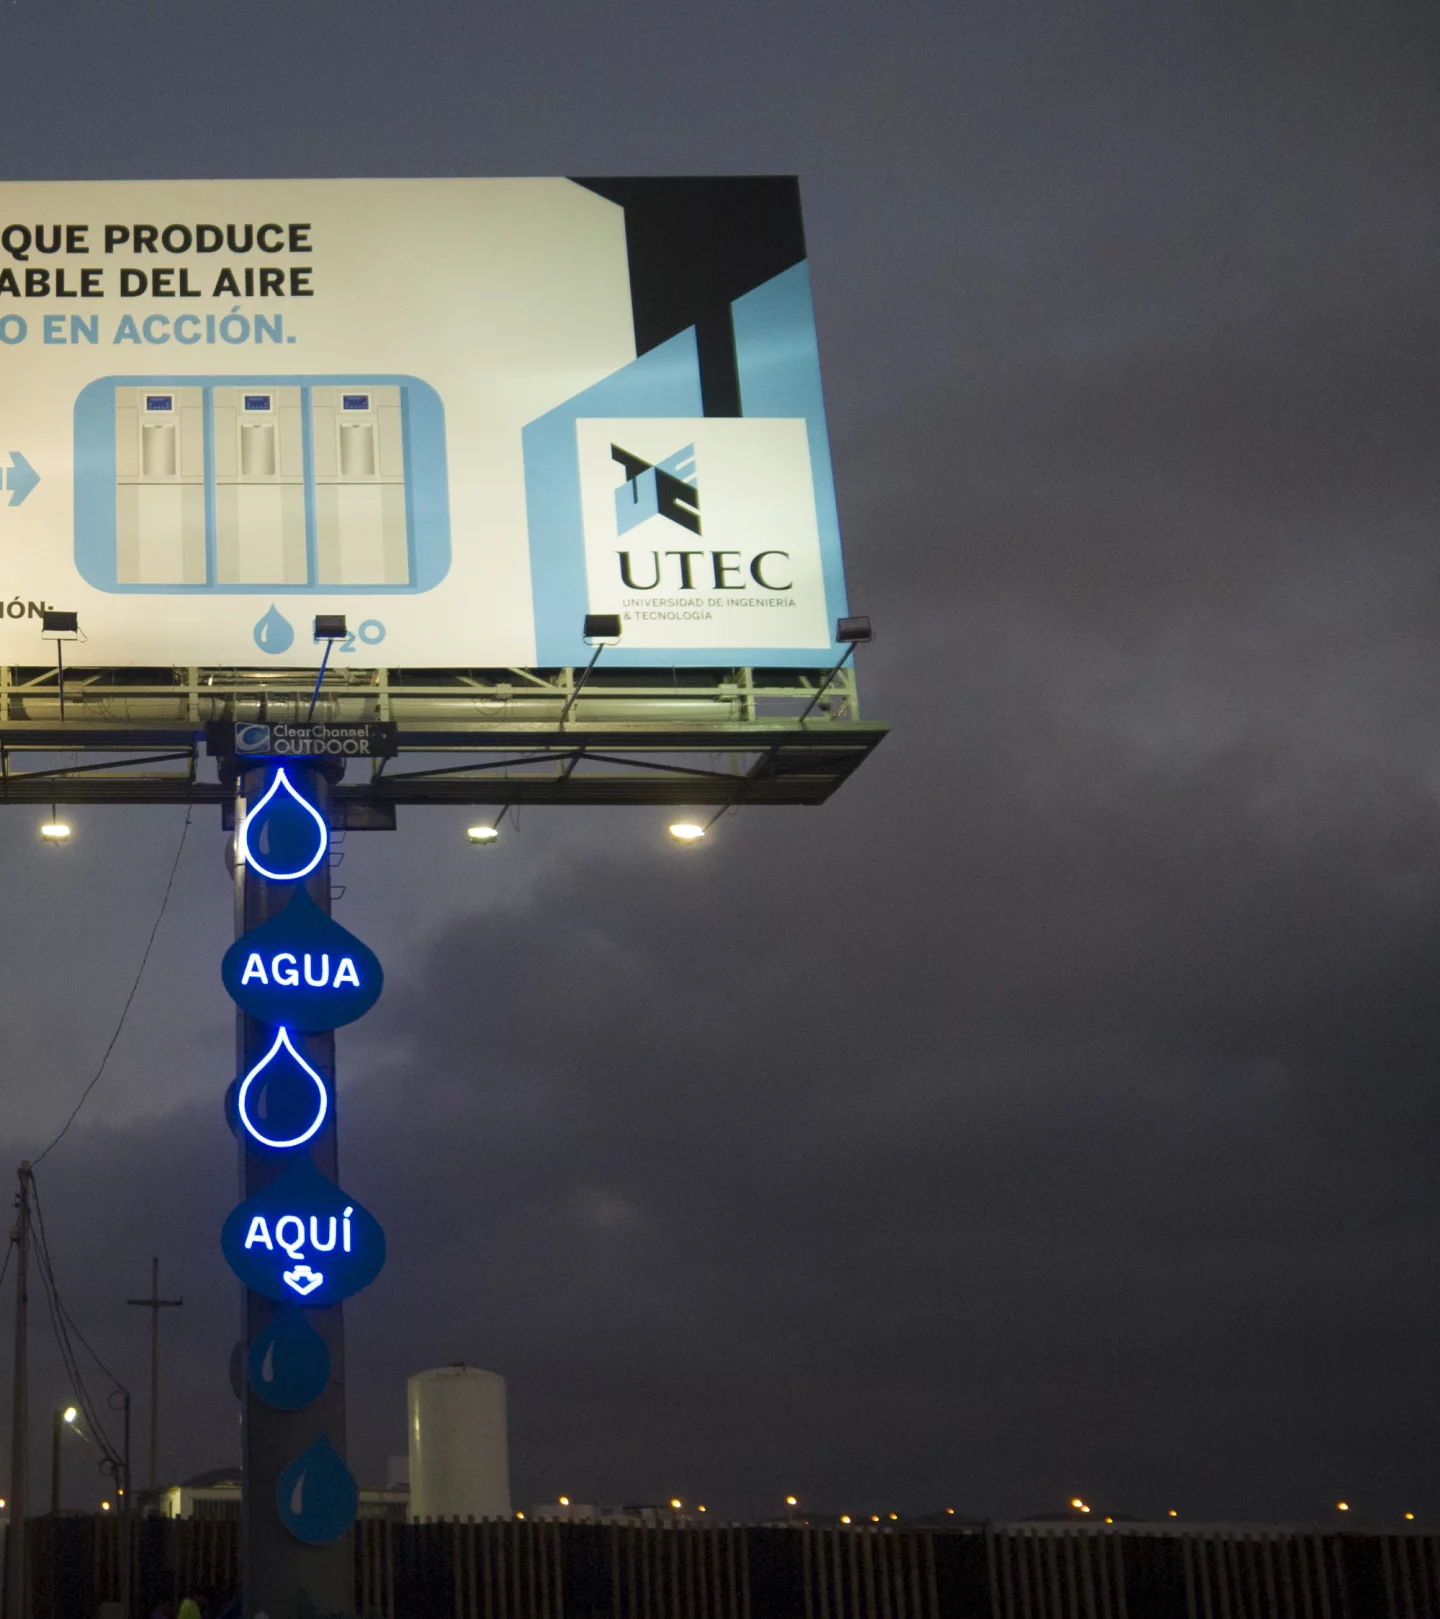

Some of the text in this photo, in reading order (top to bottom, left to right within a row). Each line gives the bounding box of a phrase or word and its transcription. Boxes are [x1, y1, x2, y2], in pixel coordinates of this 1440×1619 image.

[1, 223, 90, 261] QUE
[104, 222, 314, 254] PRODUCE
[120, 267, 201, 298] DEL
[212, 266, 315, 297] AIRE
[43, 314, 100, 345] EN
[113, 306, 297, 345] ACCIÓN.
[615, 550, 793, 590] UTEC
[622, 596, 796, 608] UNIVERSIDAD DE INGENIERÍA
[624, 609, 712, 620] & TECNOLOGÍA
[274, 739, 370, 755] OUTDOOR
[241, 952, 361, 989] AGUA
[244, 1206, 354, 1260] AQUÍ
